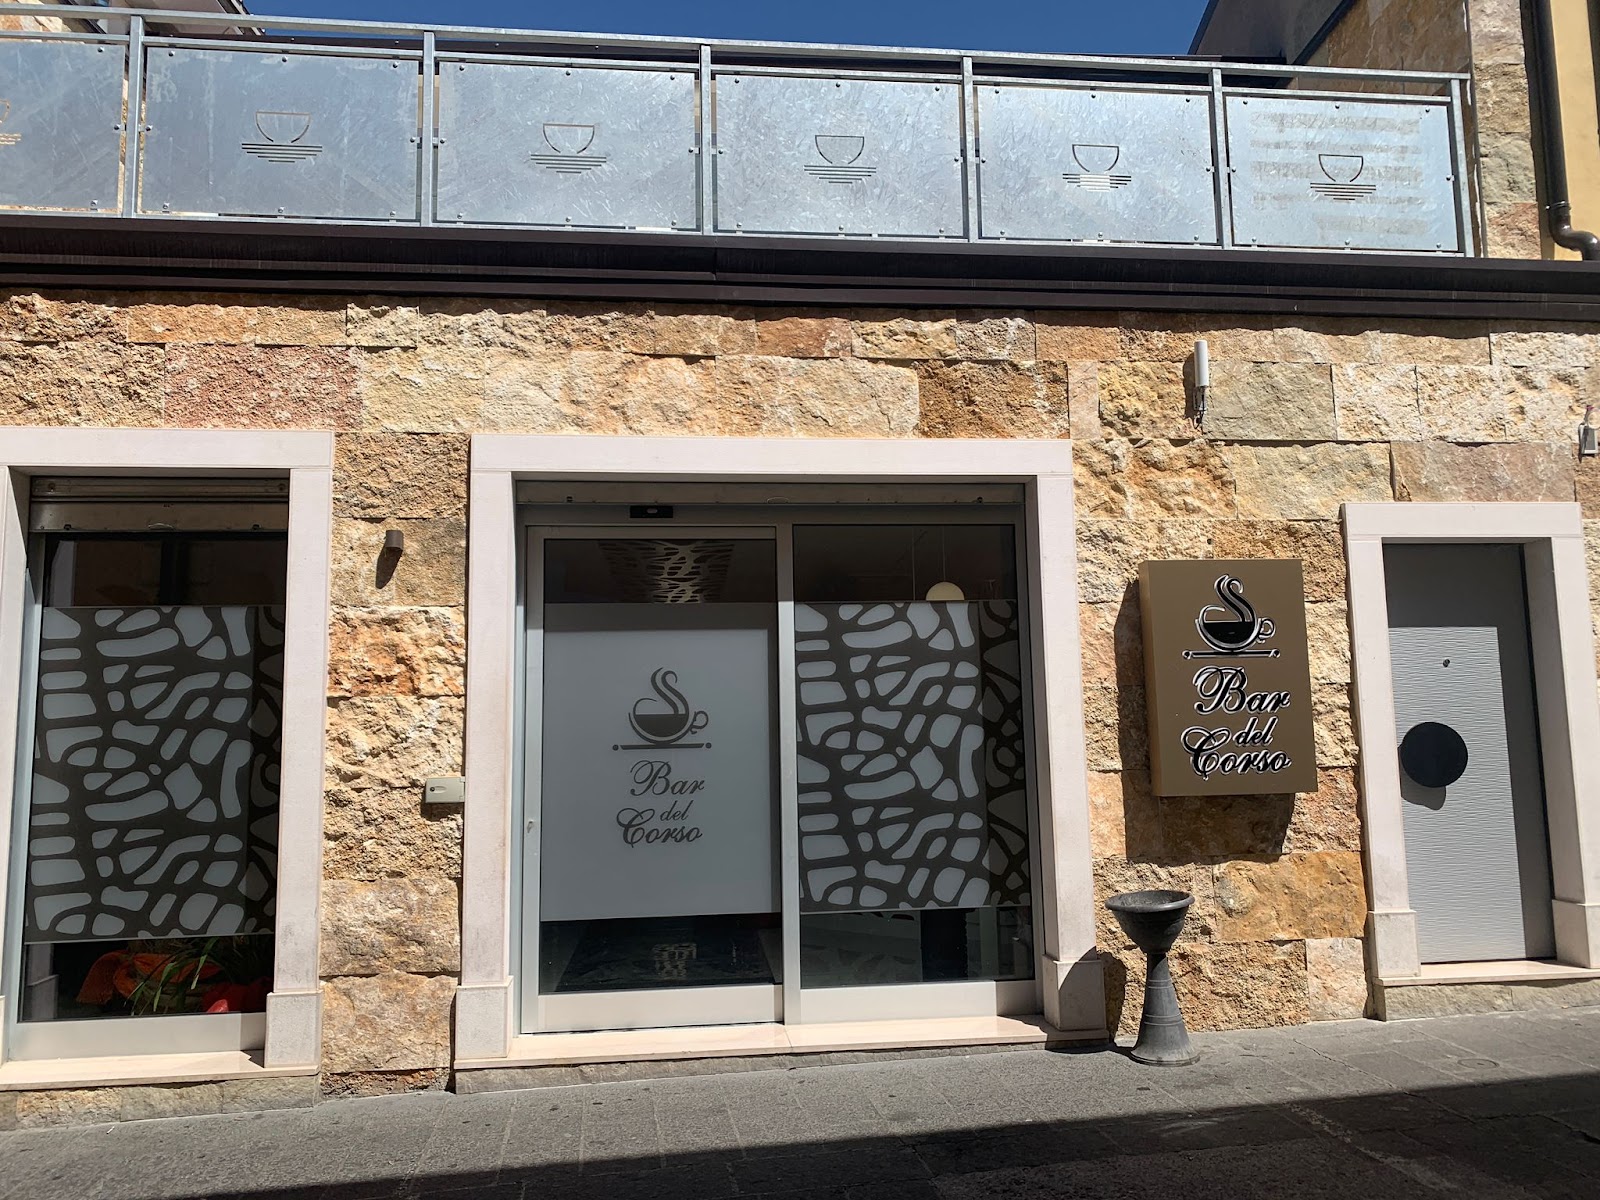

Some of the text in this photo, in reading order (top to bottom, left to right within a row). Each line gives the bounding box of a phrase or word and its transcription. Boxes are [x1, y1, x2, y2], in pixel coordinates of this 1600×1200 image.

[1193, 666, 1291, 715] Bar
[1232, 716, 1279, 746] del
[1181, 726, 1292, 781] Corso
[630, 760, 705, 796] Bar
[616, 807, 703, 848] Corso
[660, 799, 694, 821] del
